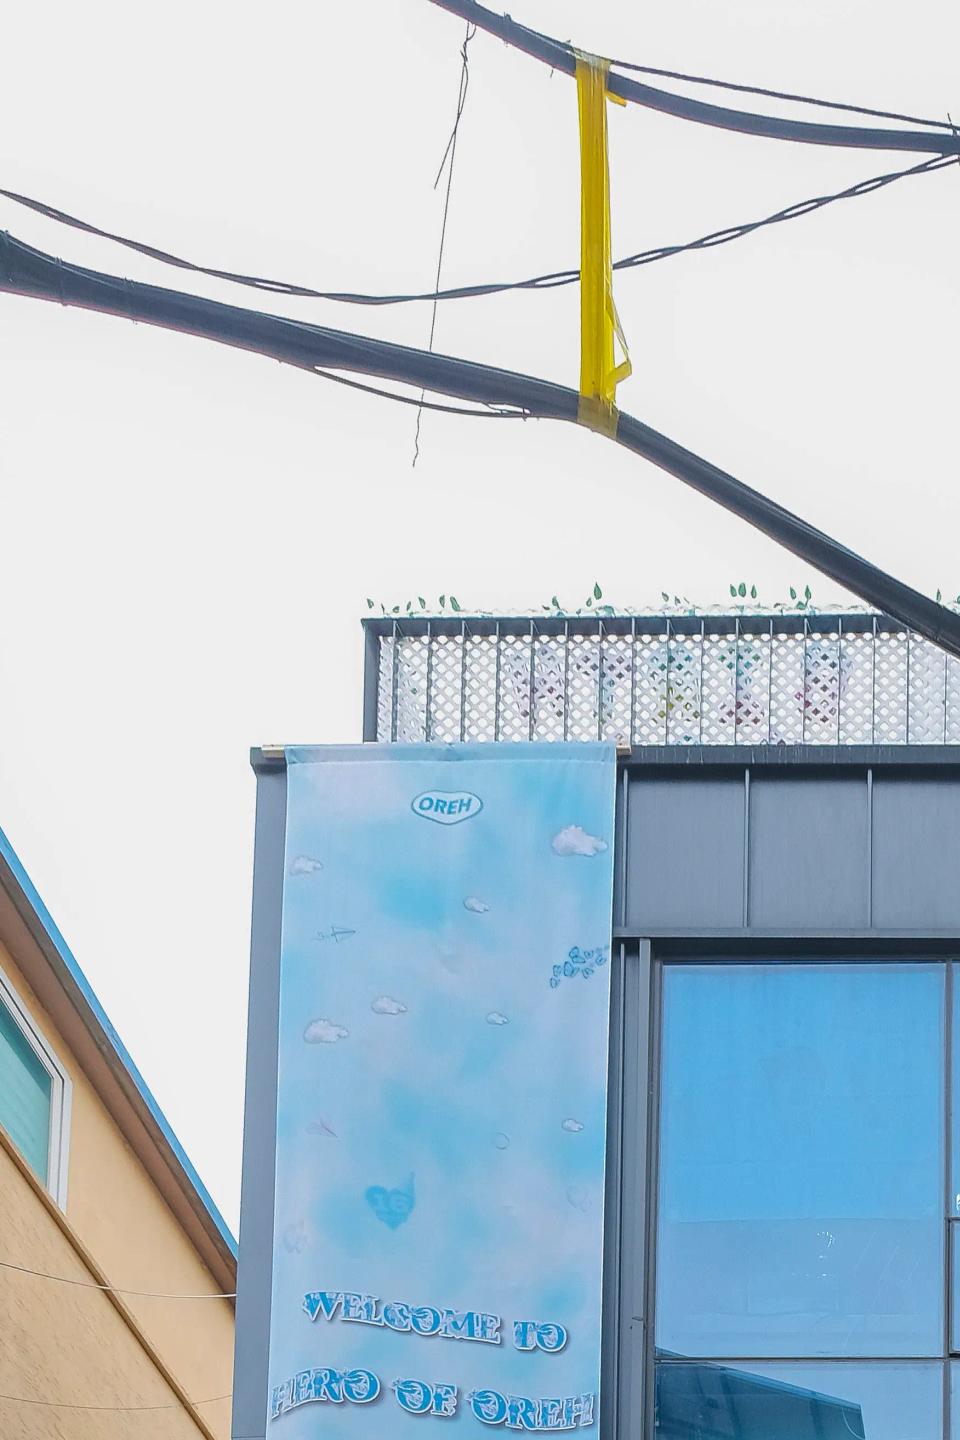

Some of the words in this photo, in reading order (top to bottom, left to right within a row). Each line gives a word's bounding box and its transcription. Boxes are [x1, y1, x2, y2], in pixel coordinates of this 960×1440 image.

[419, 797, 472, 815] OREH
[302, 1291, 502, 1344] WELCOME
[513, 1320, 567, 1353] TO
[271, 1366, 380, 1419] HERO
[392, 1376, 457, 1416] OF
[468, 1388, 595, 1431] OREH
